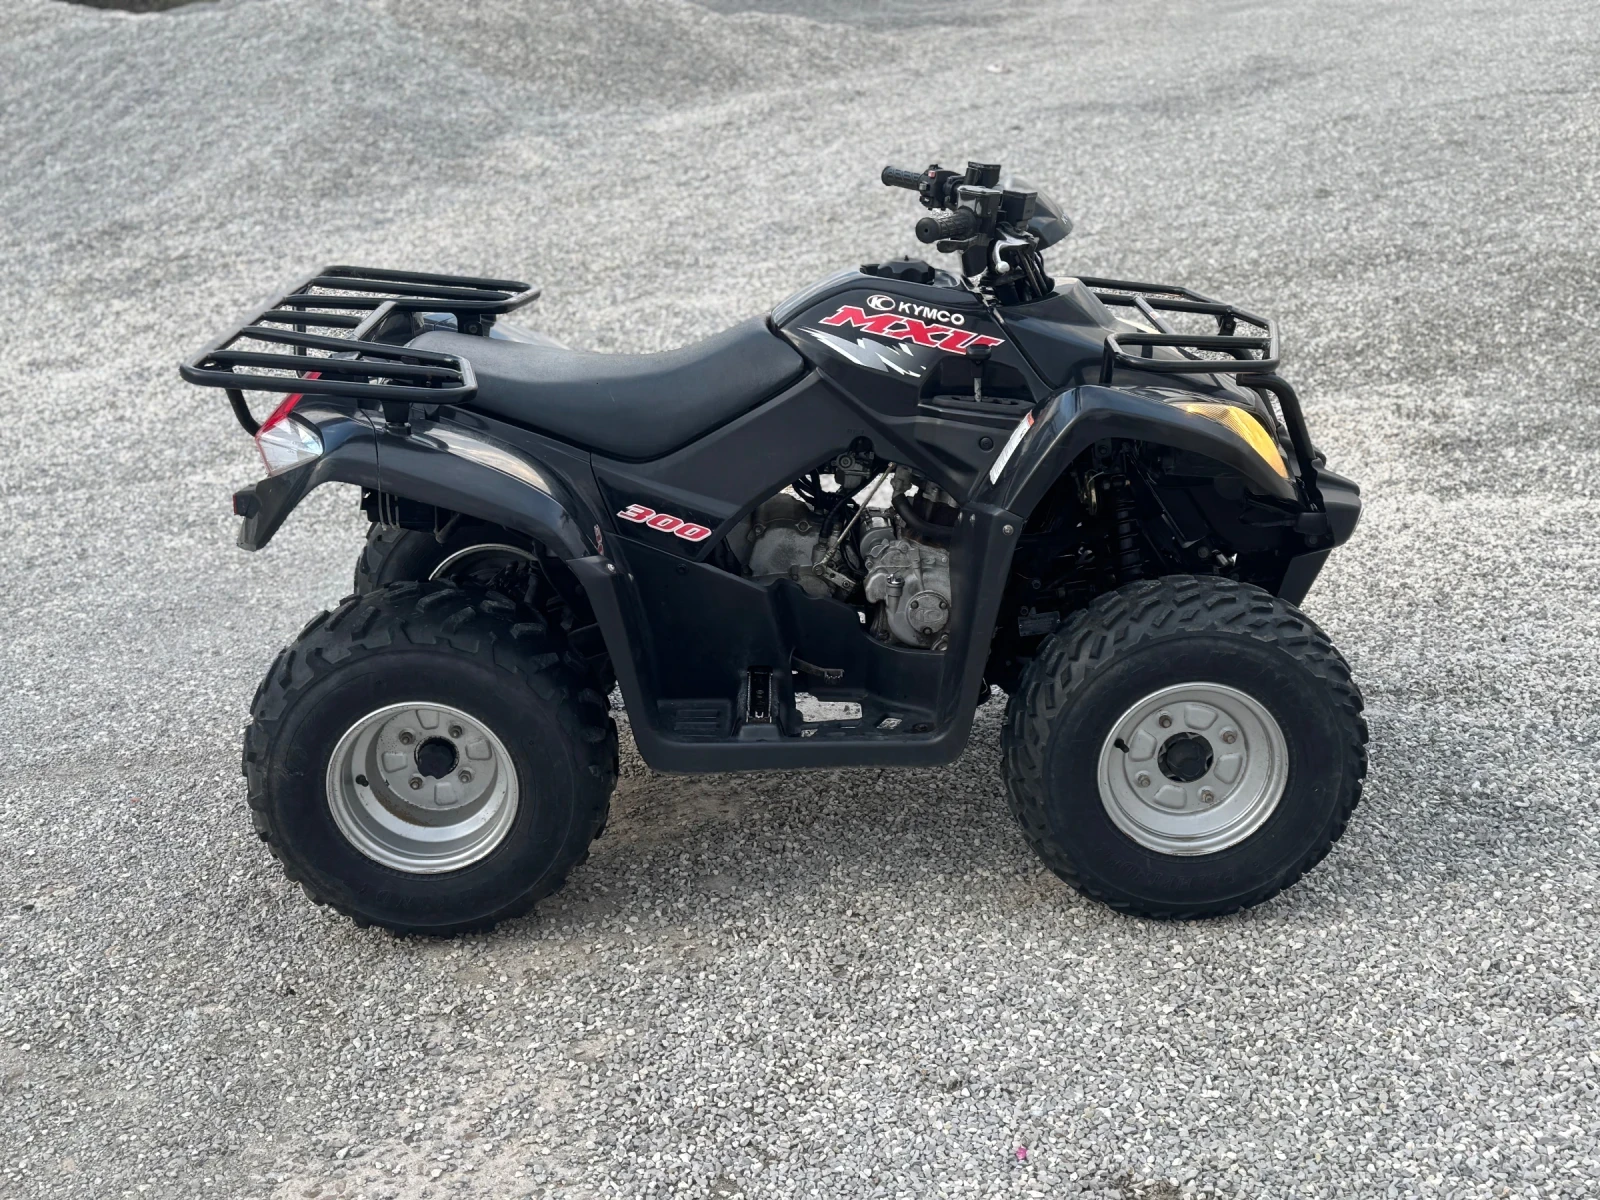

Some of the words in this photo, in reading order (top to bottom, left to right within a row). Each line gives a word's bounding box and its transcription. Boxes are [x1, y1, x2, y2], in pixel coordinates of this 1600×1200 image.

[818, 305, 1005, 355] MXU
[898, 301, 965, 325] KYMCO
[616, 504, 712, 542] 300
